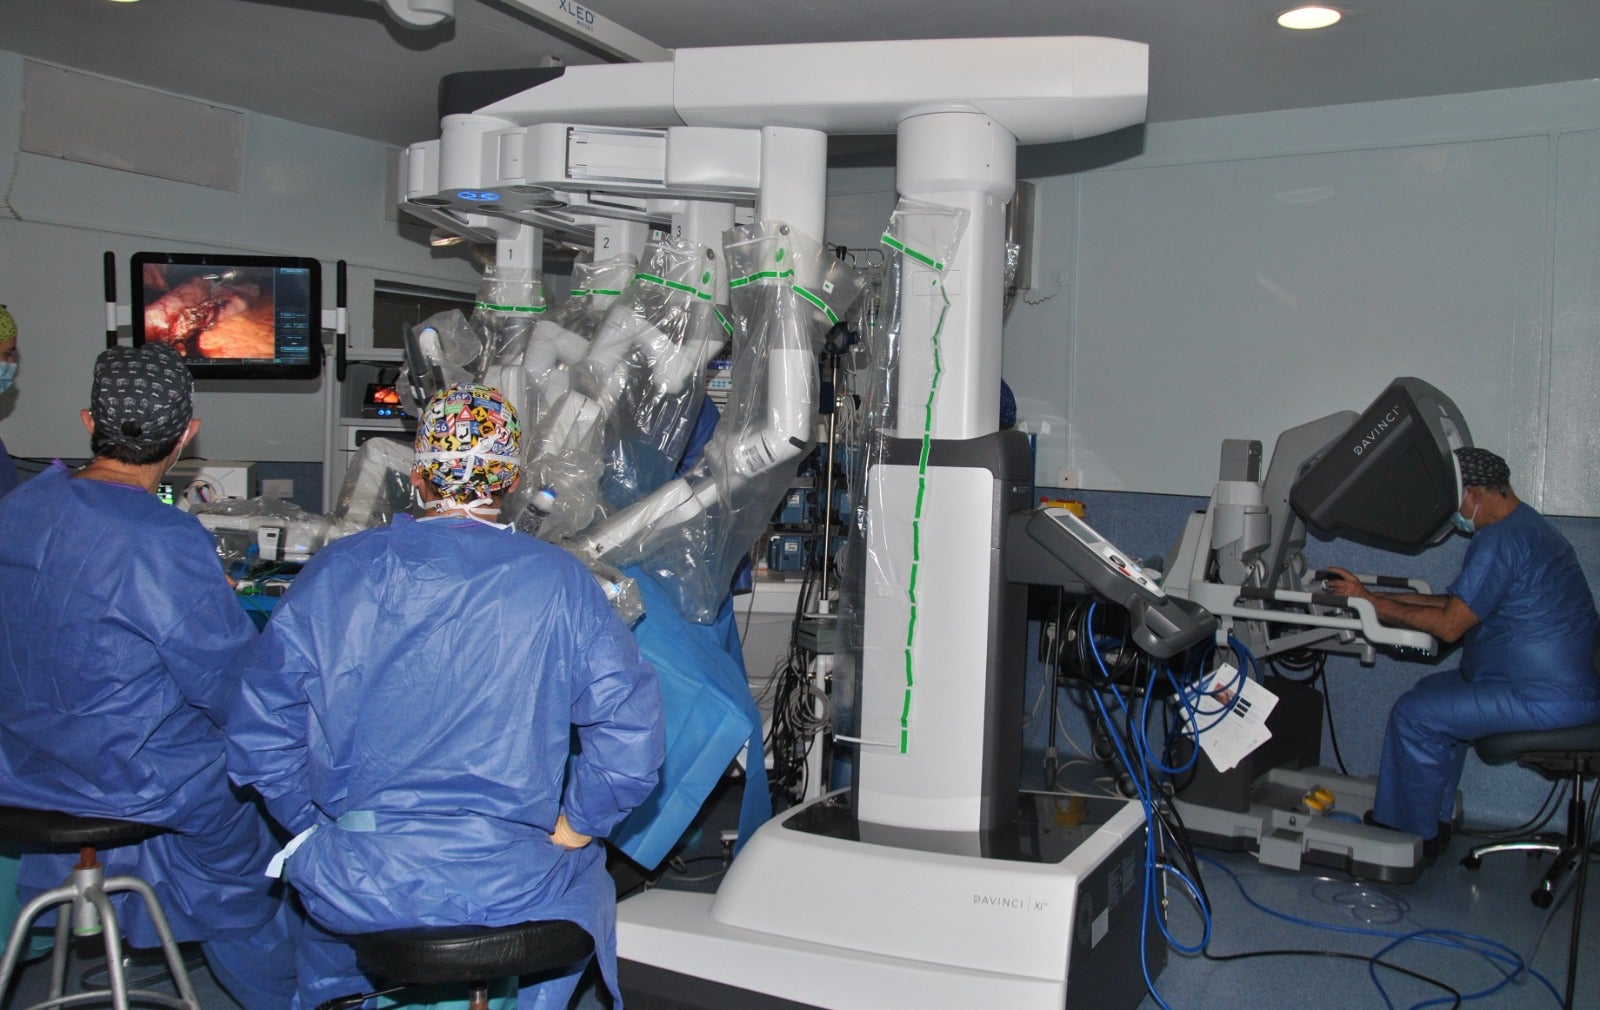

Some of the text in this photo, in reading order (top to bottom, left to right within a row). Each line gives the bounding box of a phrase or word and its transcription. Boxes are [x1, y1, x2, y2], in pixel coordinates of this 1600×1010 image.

[559, 0, 594, 24] XLED
[676, 225, 682, 238] 3
[603, 237, 610, 249] 2
[508, 248, 513, 261] 1
[435, 423, 447, 432] 95
[1353, 408, 1399, 456] DAVINCI
[973, 894, 1024, 909] DAVINCI
